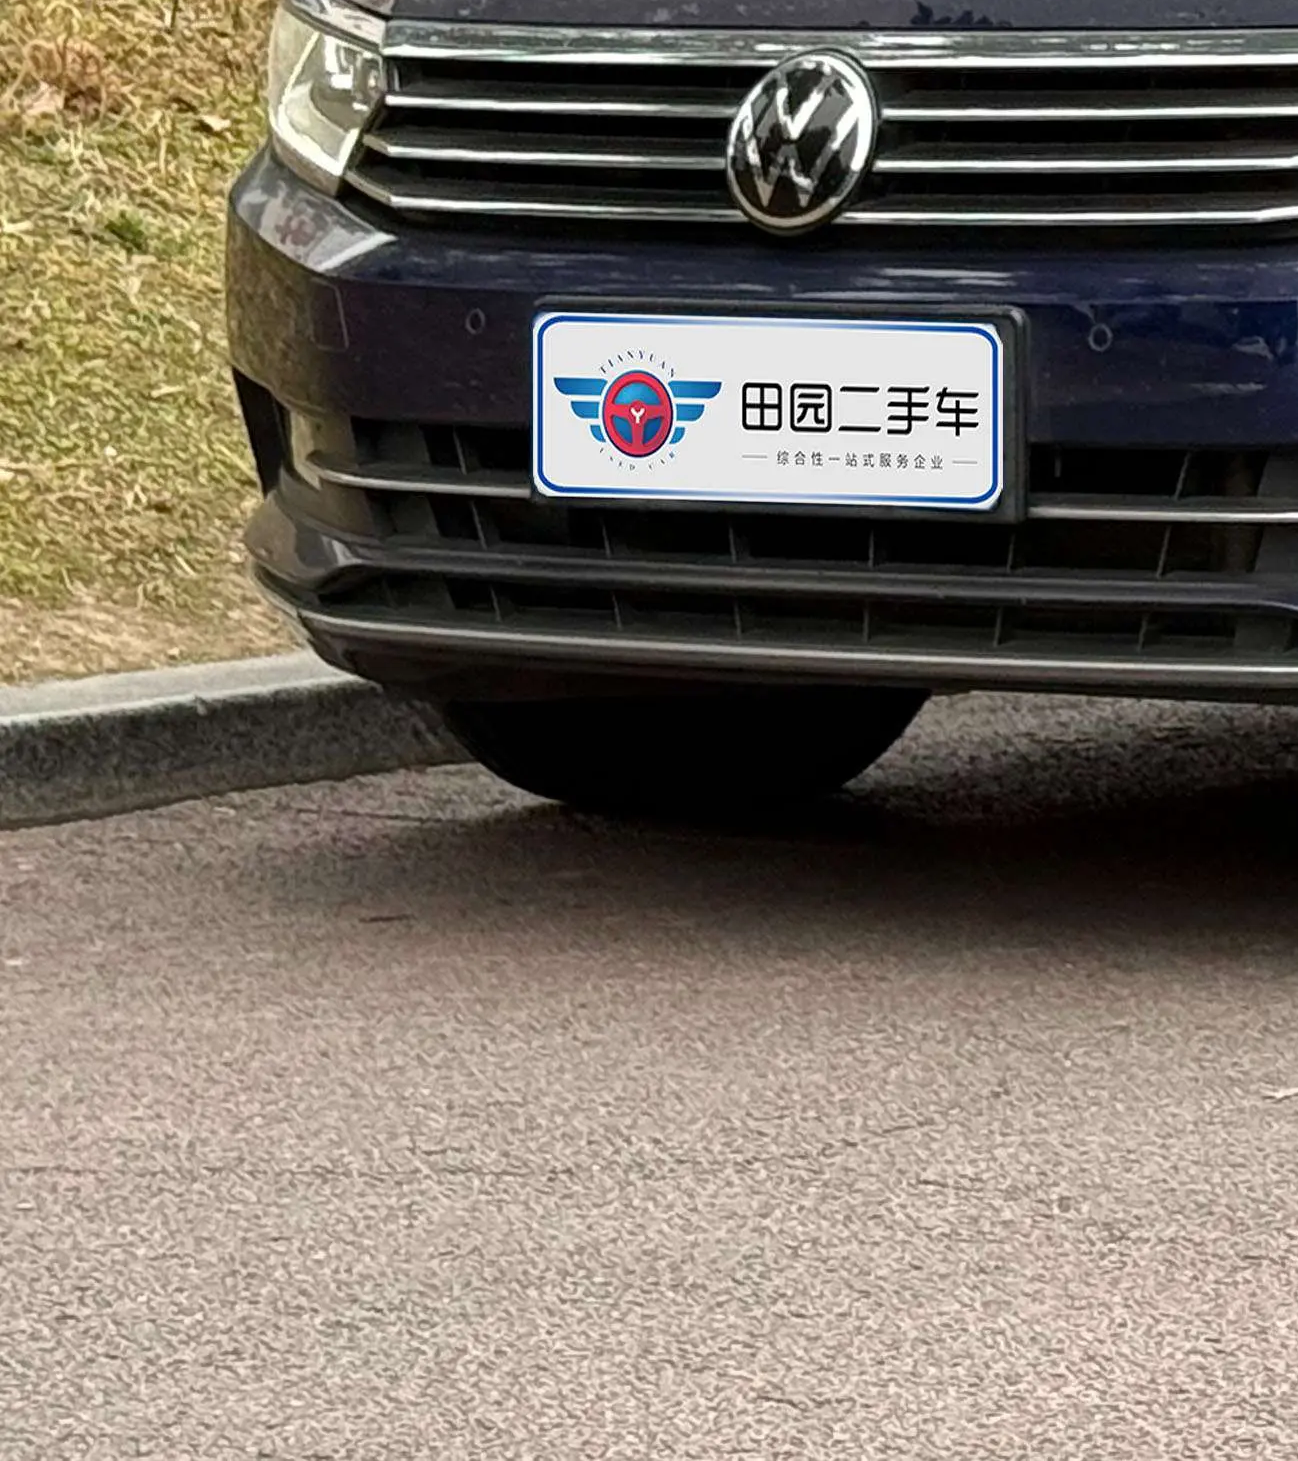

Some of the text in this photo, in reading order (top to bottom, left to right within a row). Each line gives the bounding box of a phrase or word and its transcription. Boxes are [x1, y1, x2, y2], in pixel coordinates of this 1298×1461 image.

[741, 382, 980, 437] 田园二手车
[776, 450, 944, 470] 综合性一站式服务企业
